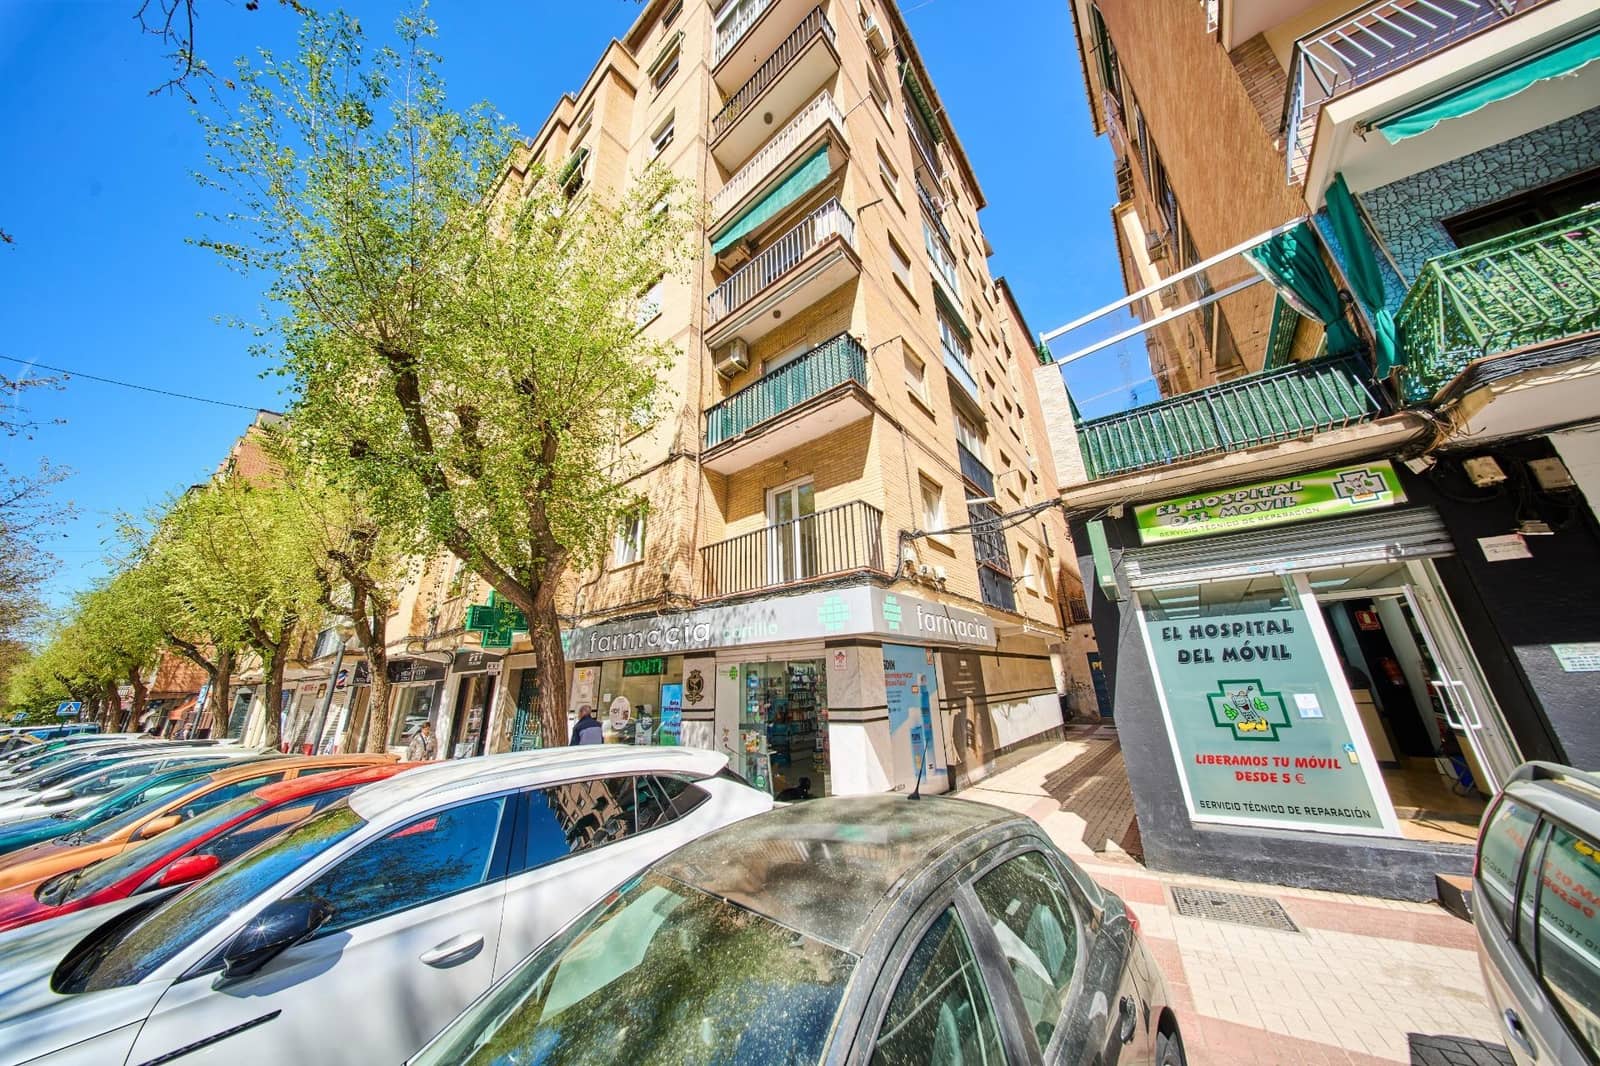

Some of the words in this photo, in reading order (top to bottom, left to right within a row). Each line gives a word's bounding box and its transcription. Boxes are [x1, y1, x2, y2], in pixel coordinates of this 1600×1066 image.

[1156, 504, 1180, 516] EL
[1185, 480, 1304, 510] HOSPITAL
[1159, 526, 1199, 537] SERVICIO
[1242, 517, 1256, 525] DE
[1170, 510, 1212, 527] DEL
[917, 604, 988, 639] farmacia
[1162, 626, 1182, 641] EL
[1189, 618, 1295, 639] HOSPITAL
[589, 618, 710, 653] farmacia
[1178, 648, 1214, 664] DEL
[1222, 640, 1292, 662] MÓVIL
[1195, 754, 1268, 767] LIBERAMOS
[1272, 757, 1290, 768] TU
[1294, 755, 1342, 769] MÓVIL
[1235, 771, 1279, 783] DESDE
[1282, 772, 1291, 784] 5
[1295, 773, 1306, 785] €
[1199, 800, 1241, 811] SERVICIO
[1242, 801, 1285, 814] TÉCNICO
[1287, 805, 1302, 815] DE
[1304, 806, 1371, 818] REPARACIÓN
